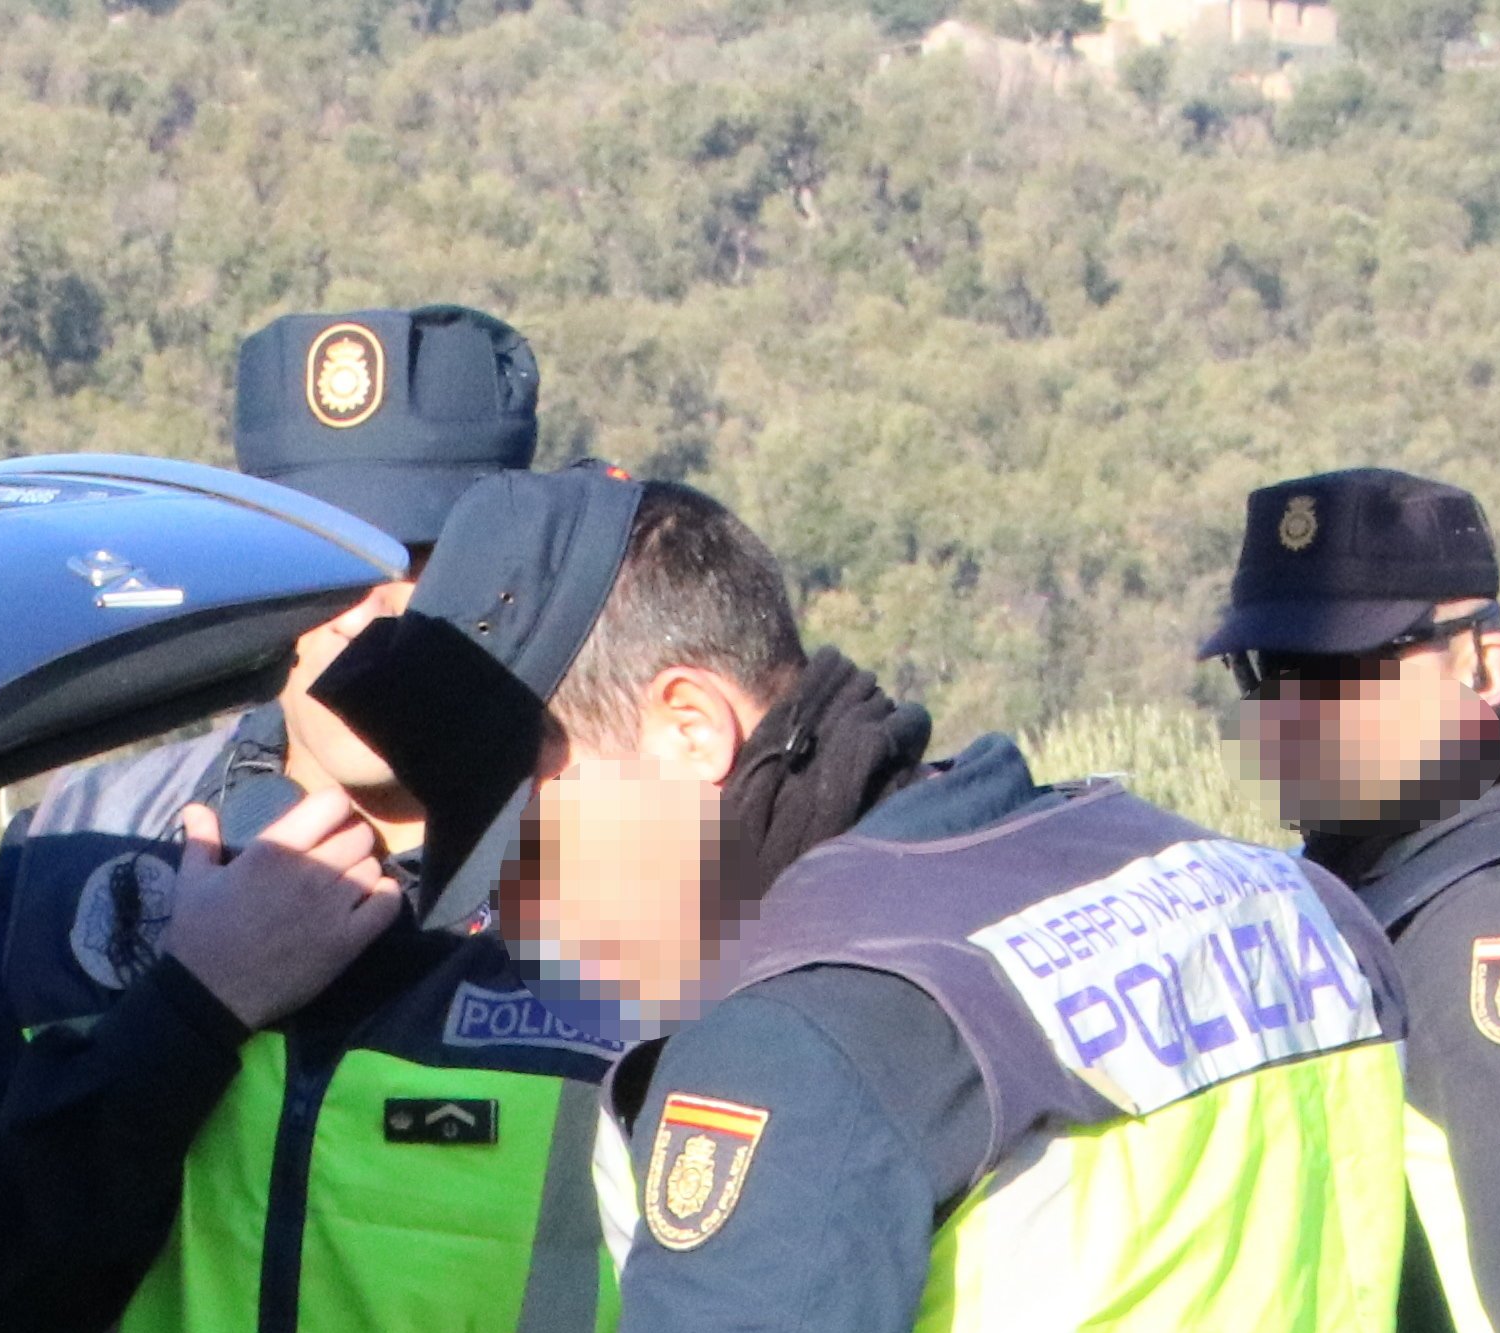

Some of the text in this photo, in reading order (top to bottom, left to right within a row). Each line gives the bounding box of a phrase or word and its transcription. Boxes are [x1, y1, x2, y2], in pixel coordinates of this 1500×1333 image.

[1005, 895, 1147, 979] CUERPO
[1126, 851, 1272, 930] NACIONAL
[1054, 912, 1358, 1069] POLICIA
